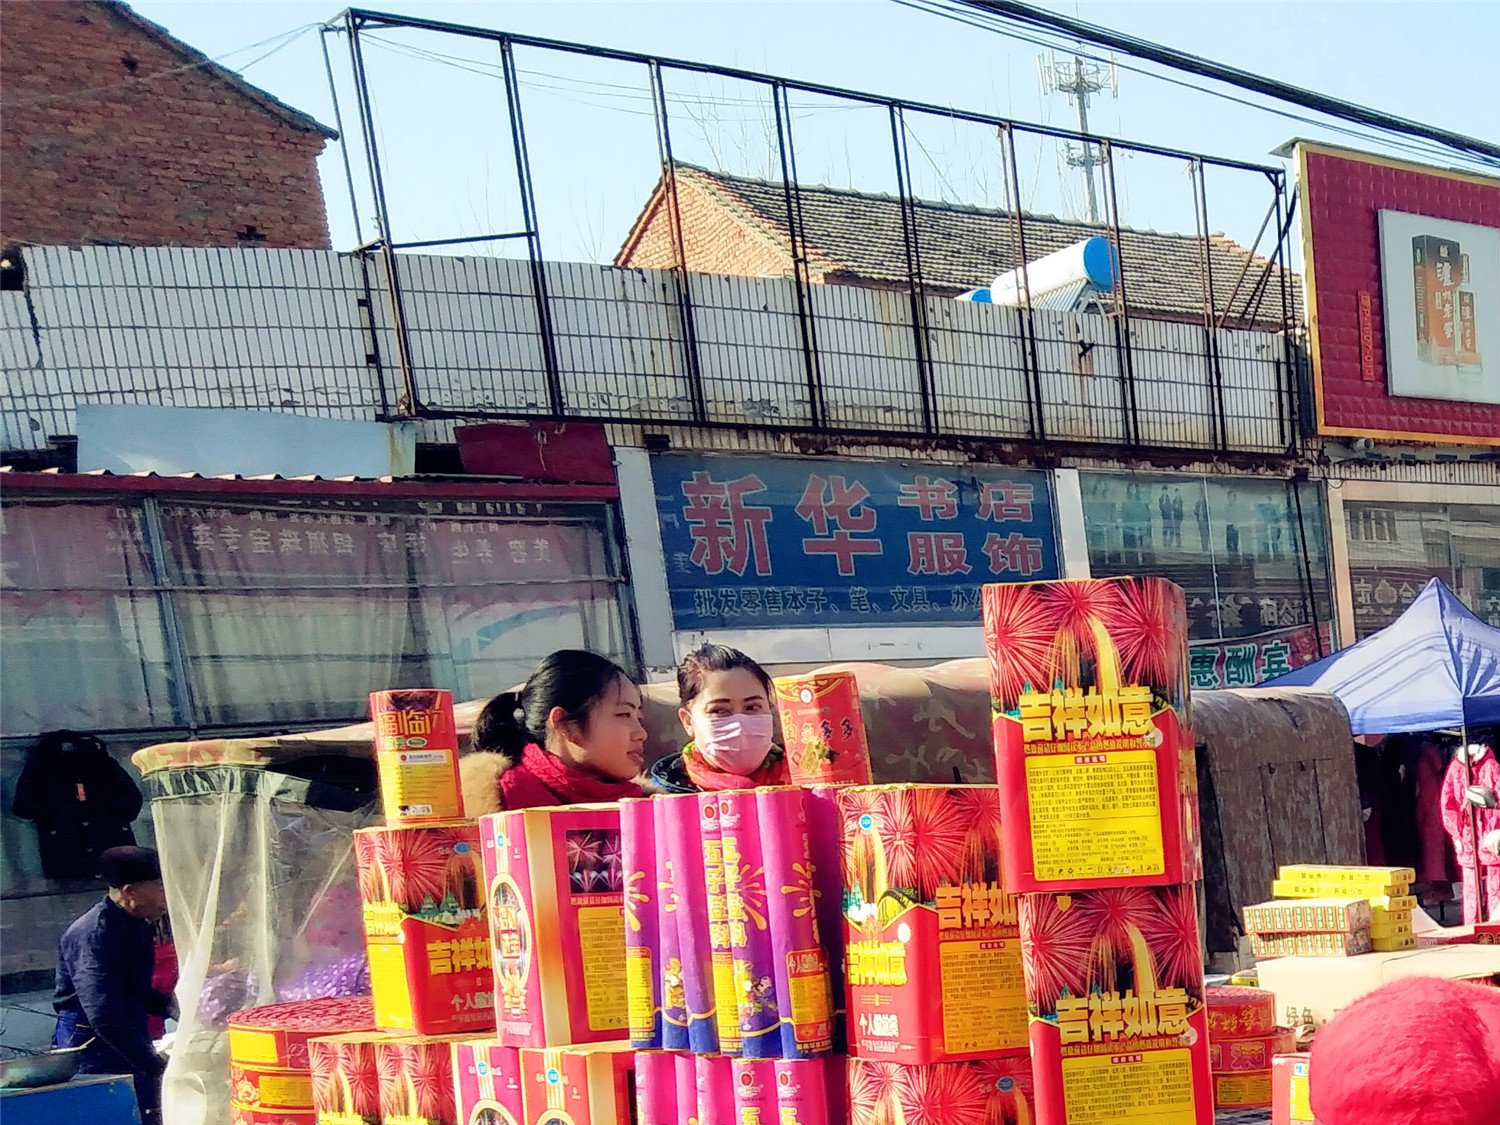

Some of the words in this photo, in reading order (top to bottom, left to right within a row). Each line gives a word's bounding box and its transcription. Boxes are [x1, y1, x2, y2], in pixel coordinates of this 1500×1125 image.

[681, 471, 883, 578] 新华
[896, 475, 1037, 524] 书店
[906, 531, 1045, 577] 服饰
[1019, 684, 1156, 744] 吉祥如意
[1055, 987, 1191, 1046] 吉祥如意
